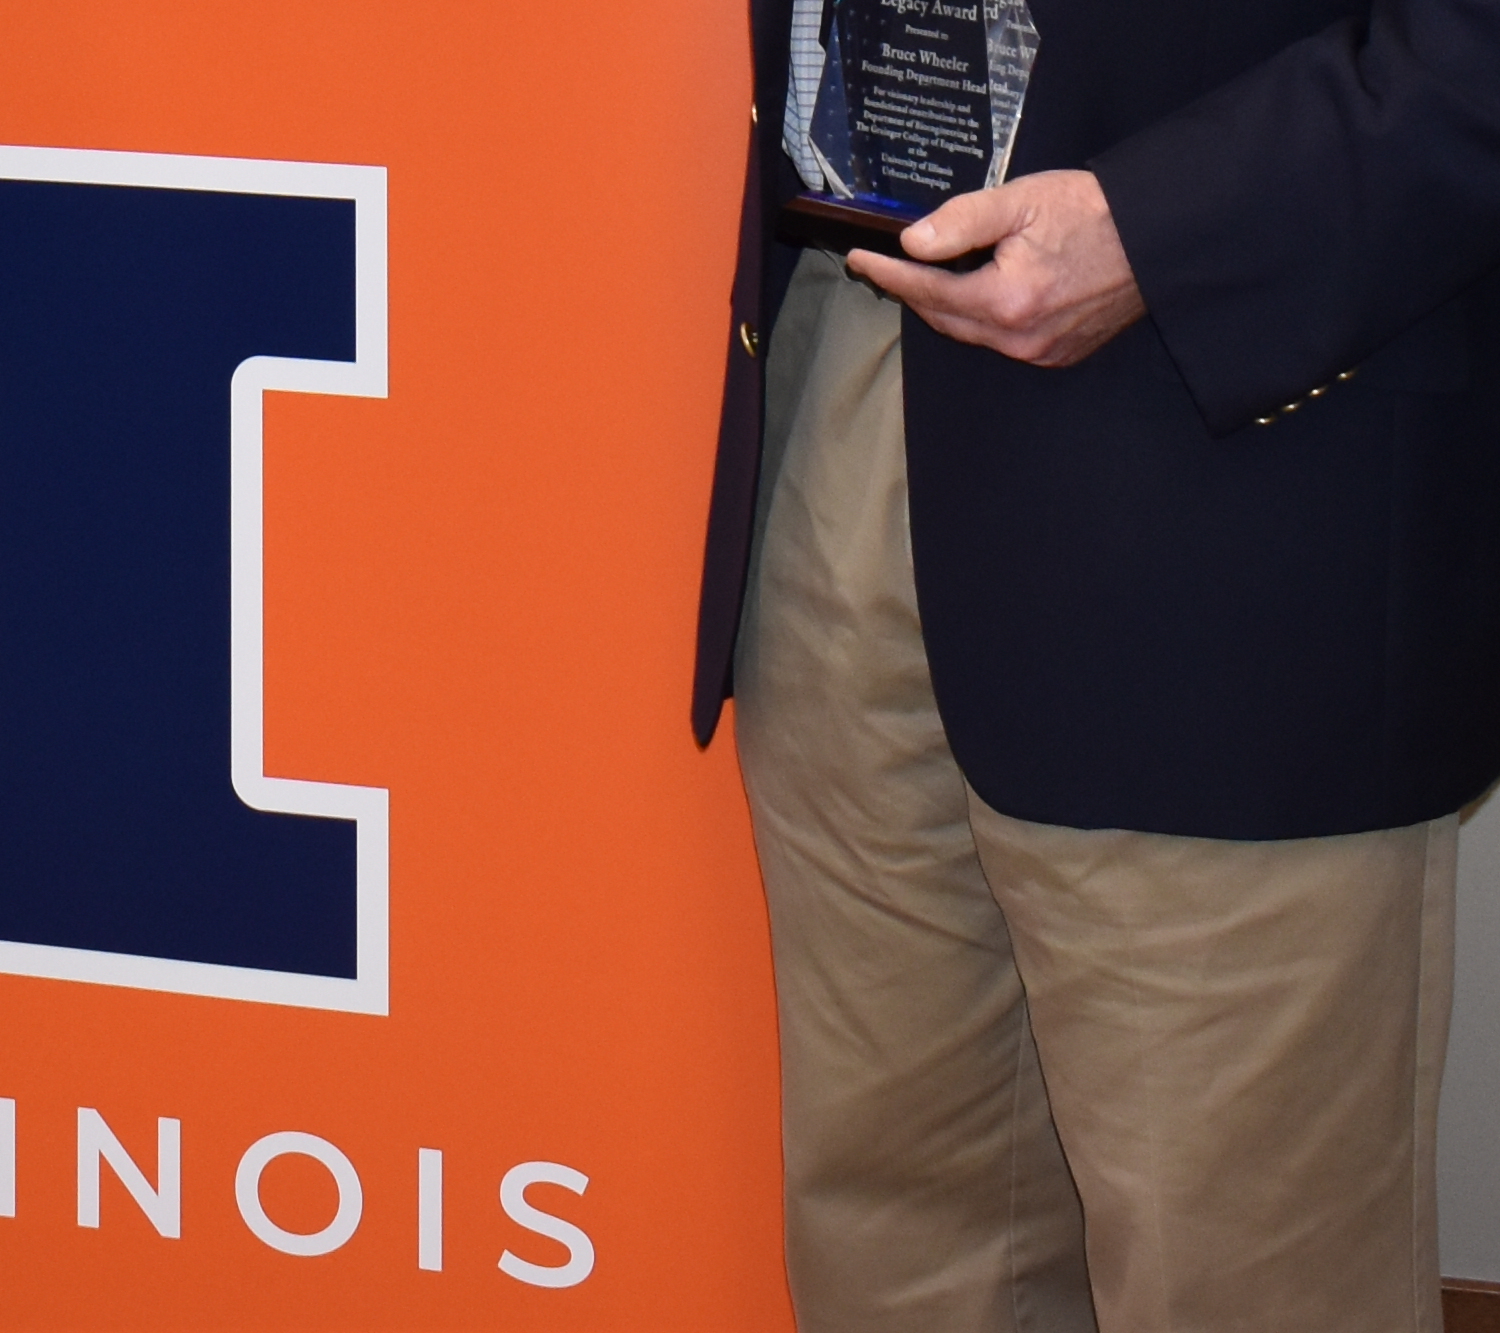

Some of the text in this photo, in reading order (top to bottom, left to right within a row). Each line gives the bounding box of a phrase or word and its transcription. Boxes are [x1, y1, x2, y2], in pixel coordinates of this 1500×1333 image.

[882, 43, 969, 73] Bruce Wheeler
[861, 60, 987, 94] Founding Department Head
